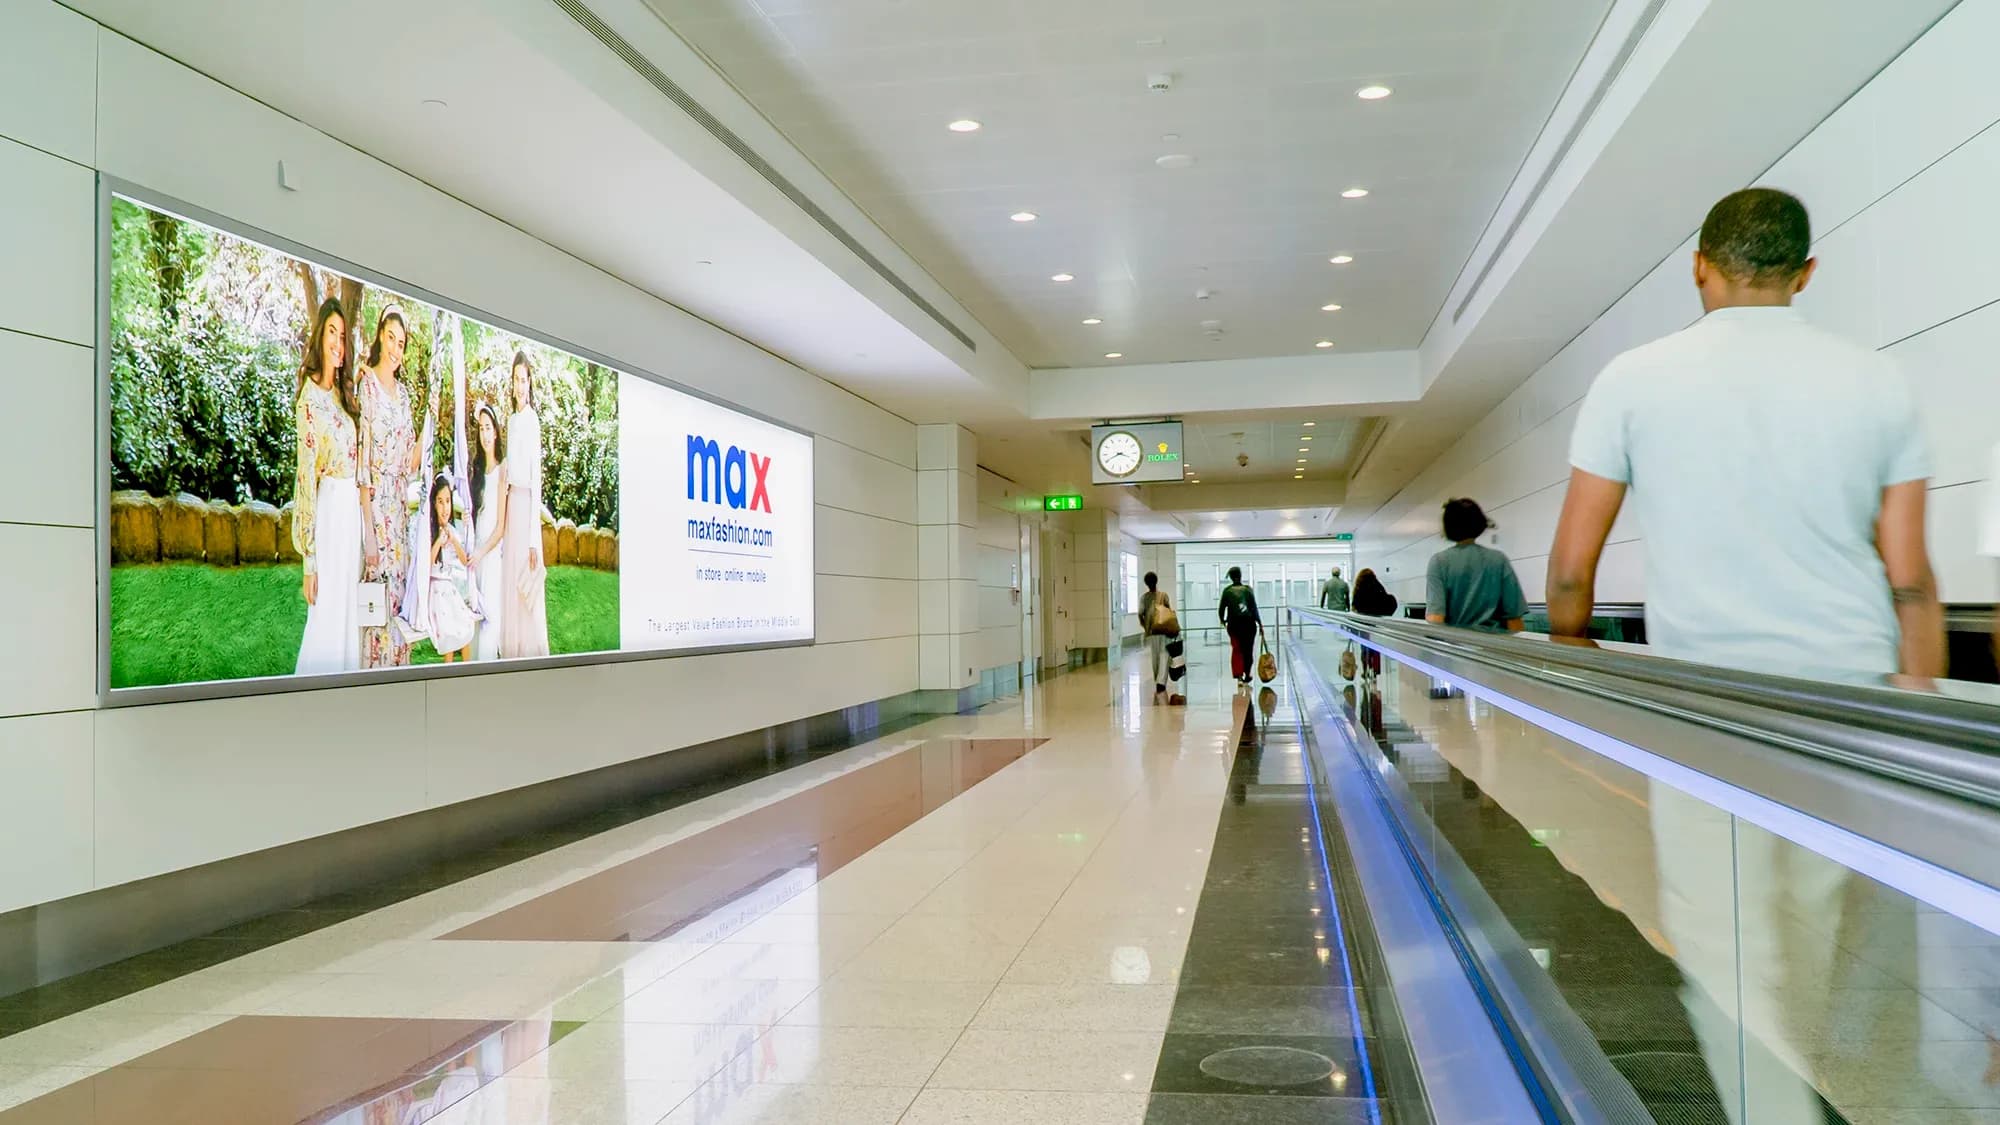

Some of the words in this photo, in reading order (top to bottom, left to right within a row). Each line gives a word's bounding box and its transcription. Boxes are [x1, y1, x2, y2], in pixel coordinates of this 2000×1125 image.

[1147, 453, 1178, 462] ROLEX
[687, 434, 772, 514] max
[687, 516, 773, 547] maxfashion.com
[696, 565, 703, 580] in
[704, 568, 721, 581] store
[725, 568, 743, 581] online
[747, 568, 766, 582] mobile
[648, 618, 661, 632] The
[664, 618, 689, 635] Largest
[692, 618, 710, 631] Value
[712, 617, 735, 630] Fashion
[736, 616, 753, 629] Brand
